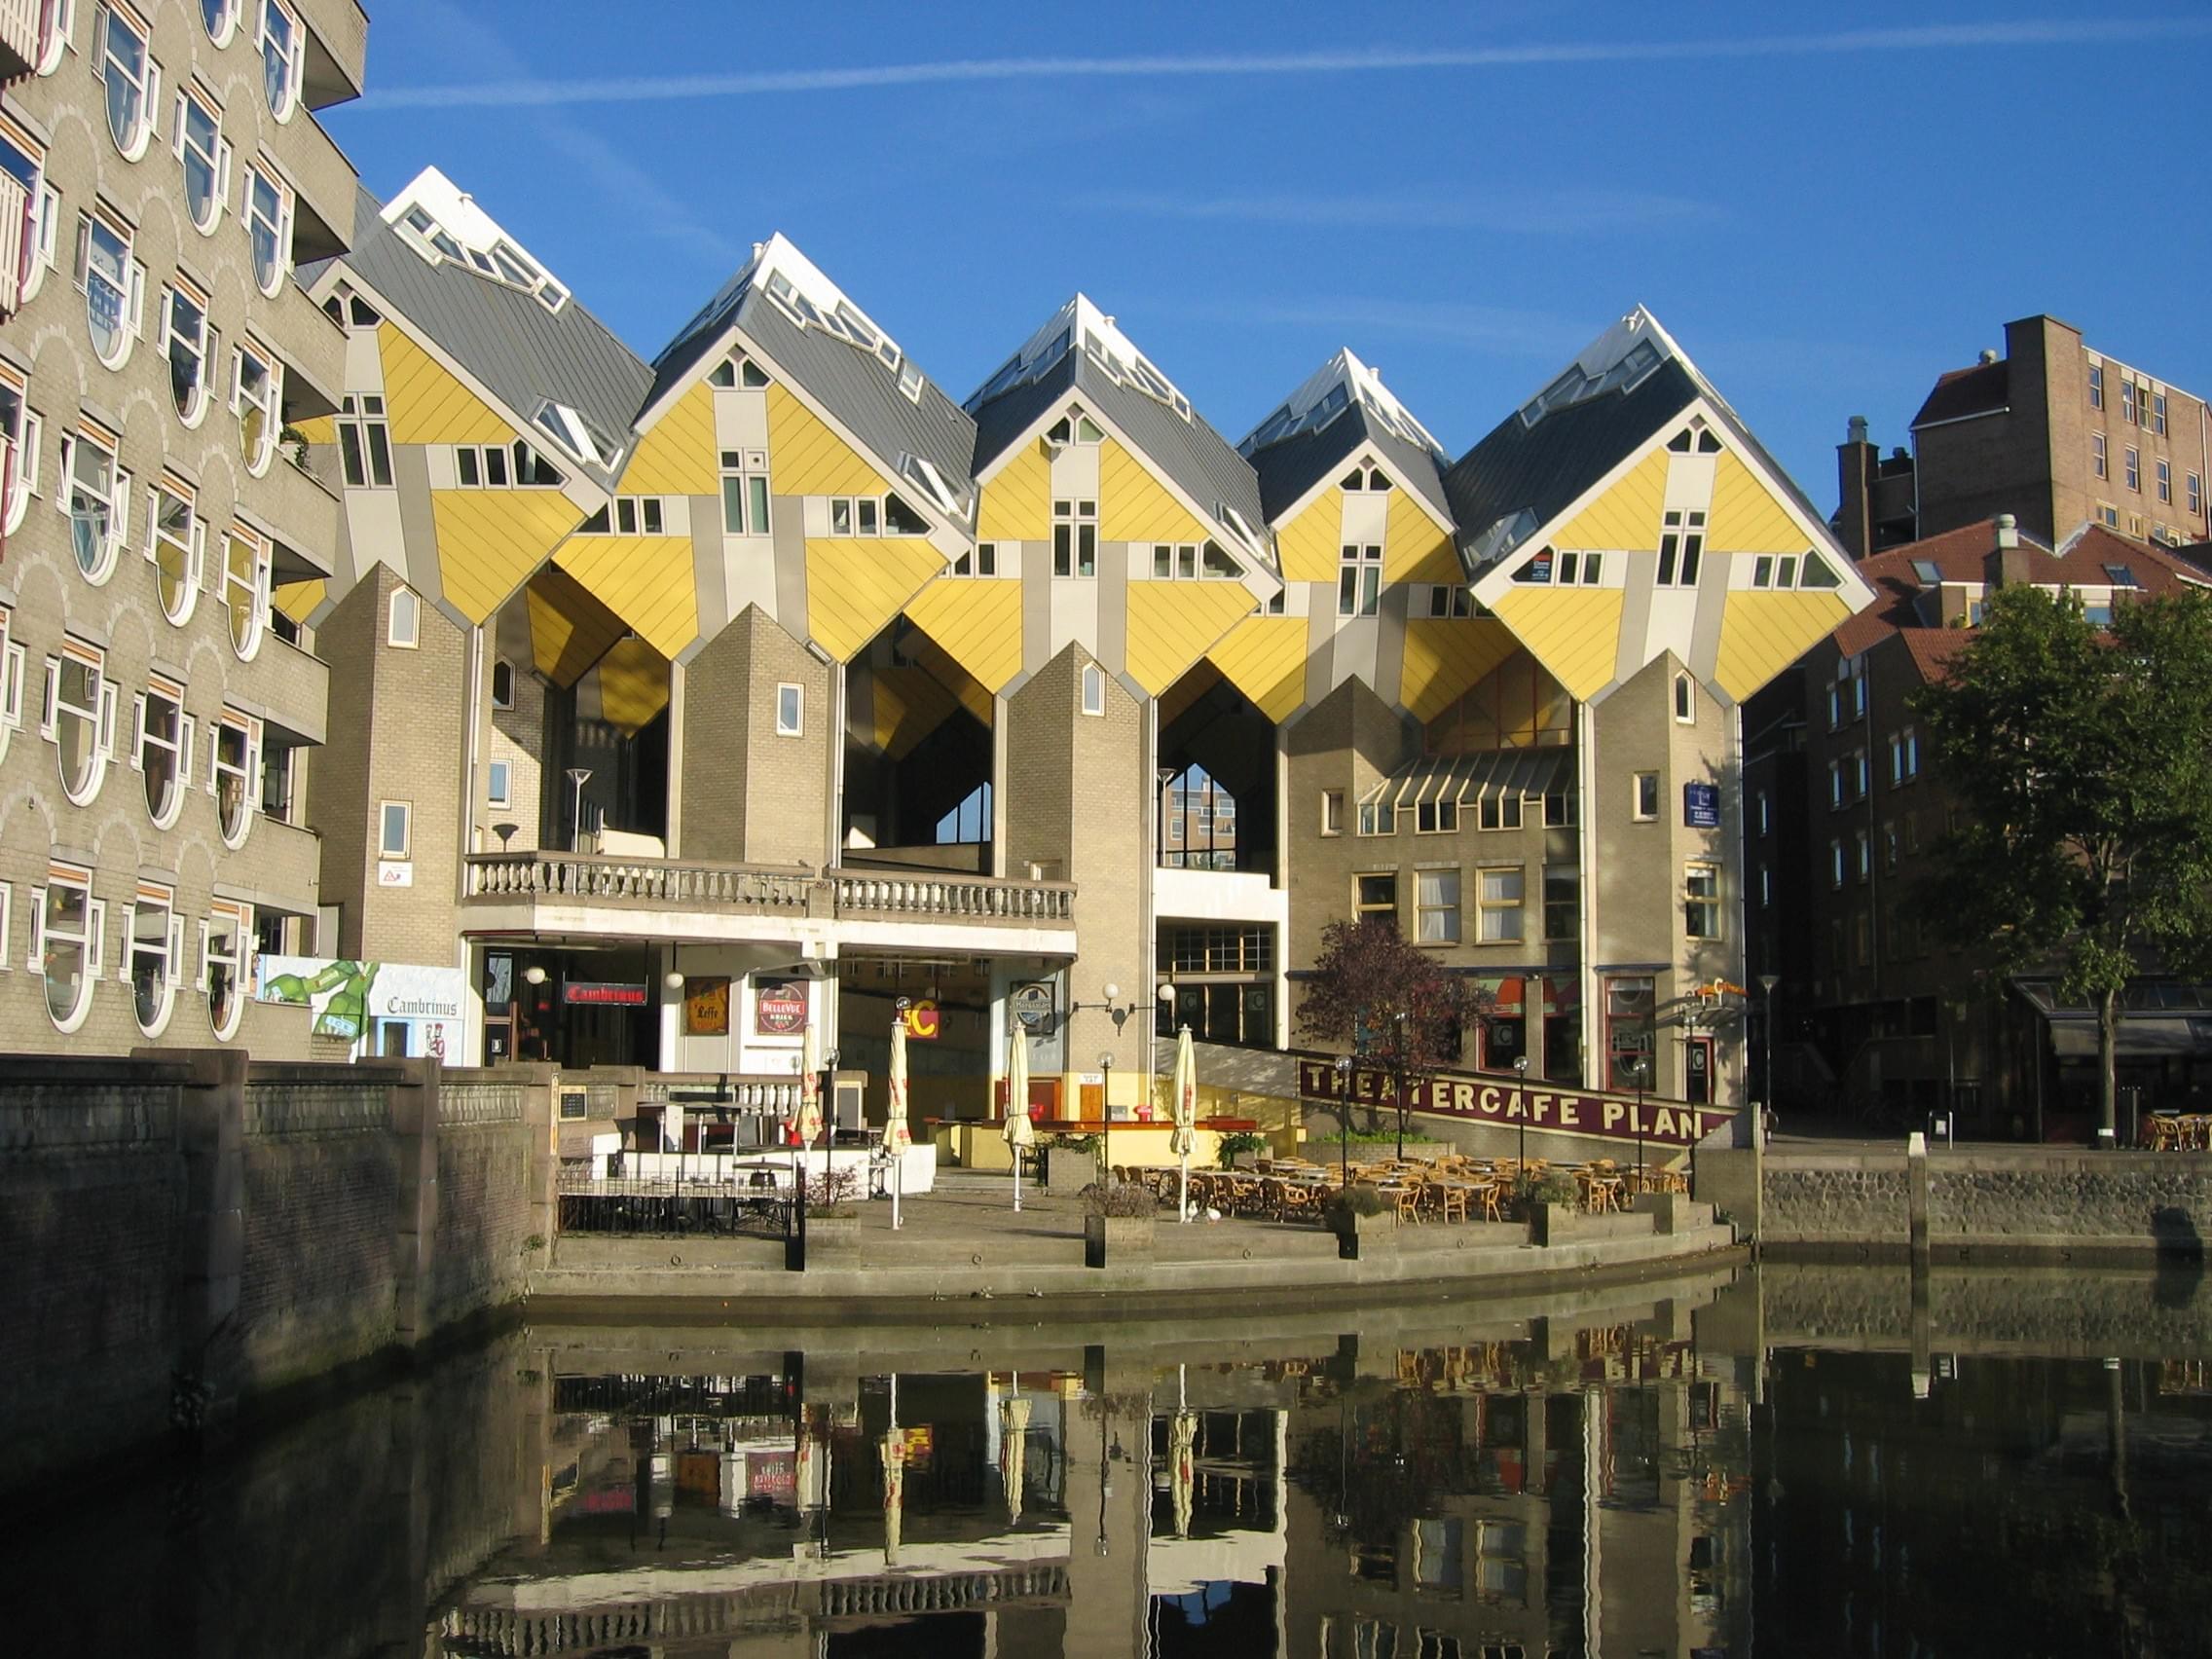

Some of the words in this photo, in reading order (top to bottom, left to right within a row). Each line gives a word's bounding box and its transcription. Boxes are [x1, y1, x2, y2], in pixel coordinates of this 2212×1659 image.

[387, 995, 458, 1015] Cambrinus
[1693, 1051, 1705, 1068] C
[1307, 1066, 1581, 1125] THEATERCAFE
[1604, 1102, 1703, 1139] PLAN
